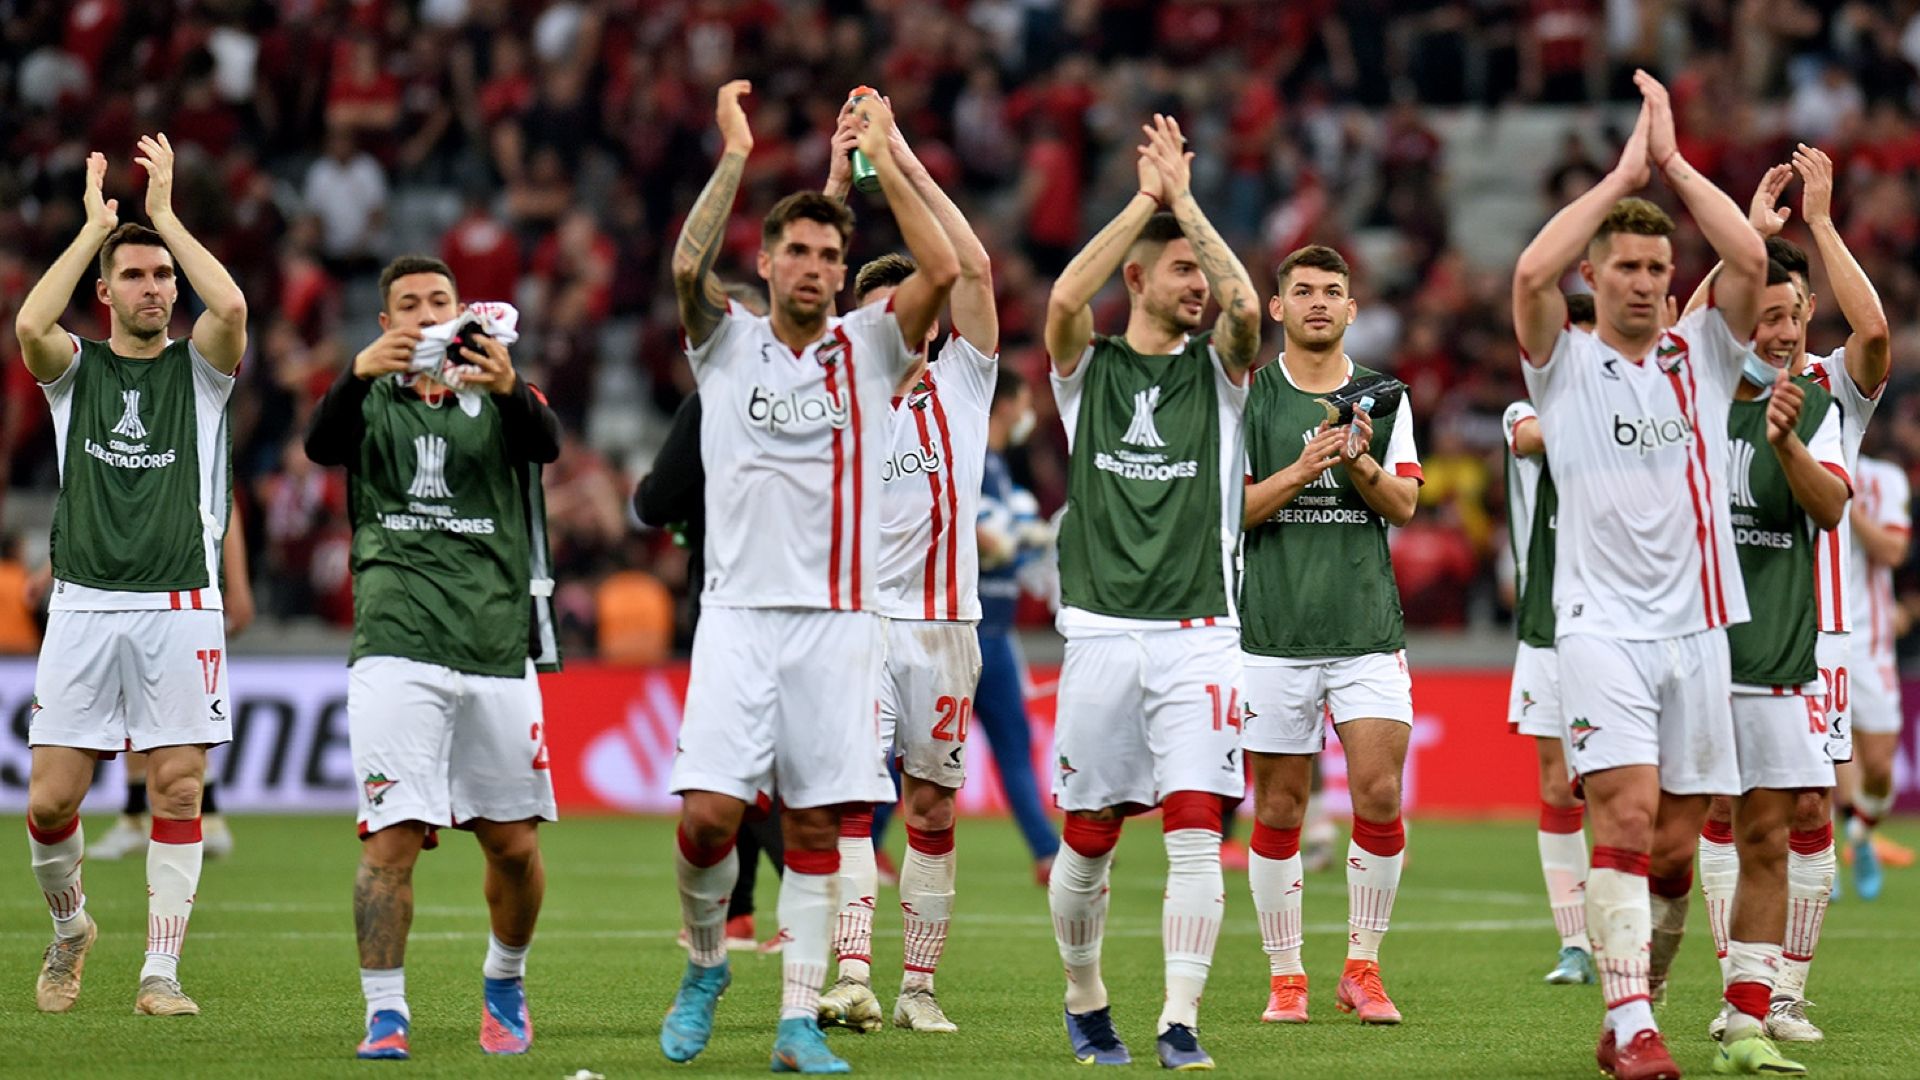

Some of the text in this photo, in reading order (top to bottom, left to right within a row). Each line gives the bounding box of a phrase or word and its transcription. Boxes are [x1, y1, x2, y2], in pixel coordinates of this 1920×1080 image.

[749, 386, 848, 432] bplay
[1266, 509, 1369, 524] BERTADORES
[196, 648, 221, 694] 17
[931, 695, 971, 743] 20
[1205, 684, 1242, 735] 14
